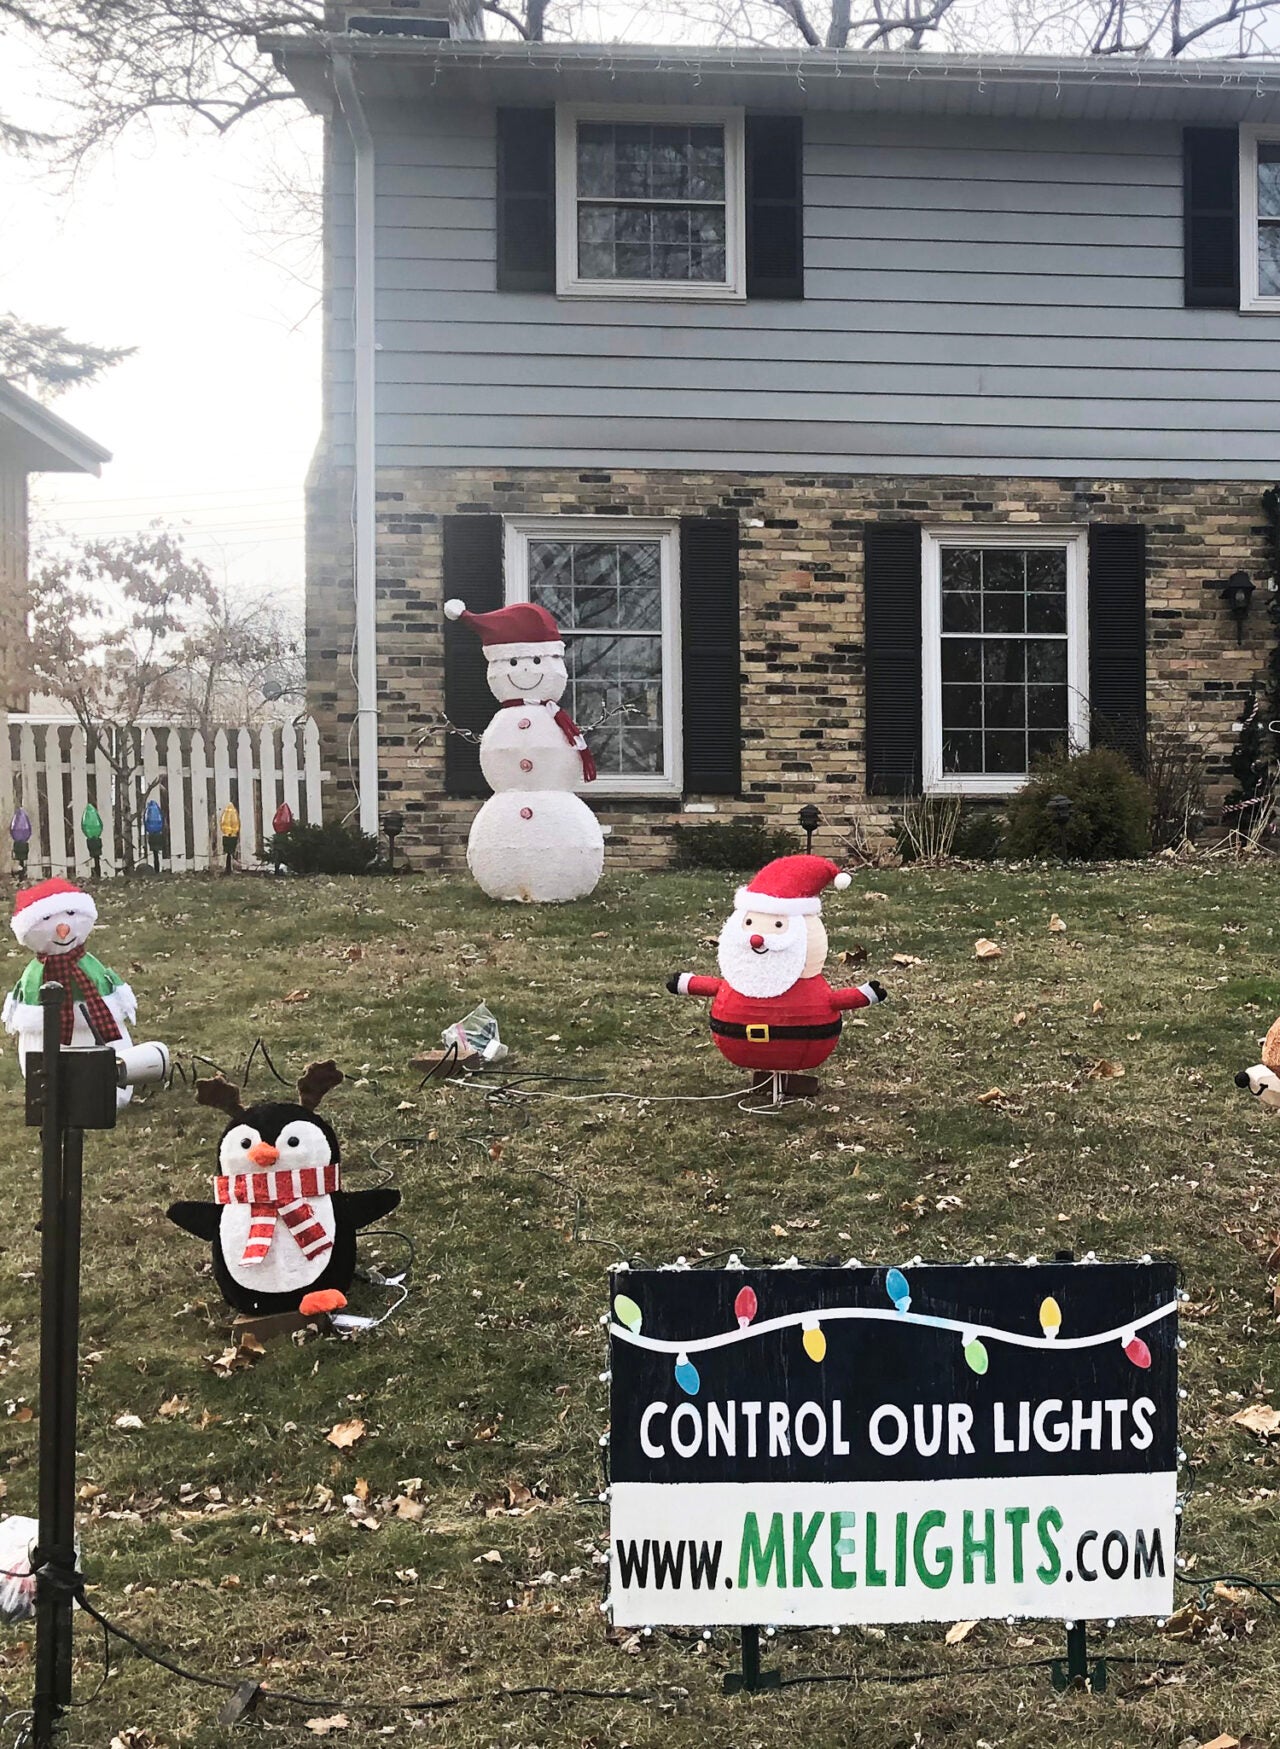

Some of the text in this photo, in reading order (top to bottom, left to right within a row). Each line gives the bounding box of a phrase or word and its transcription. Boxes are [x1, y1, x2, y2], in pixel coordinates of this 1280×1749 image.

[639, 1396, 1157, 1459] CONTROL OUR LIGHTS
